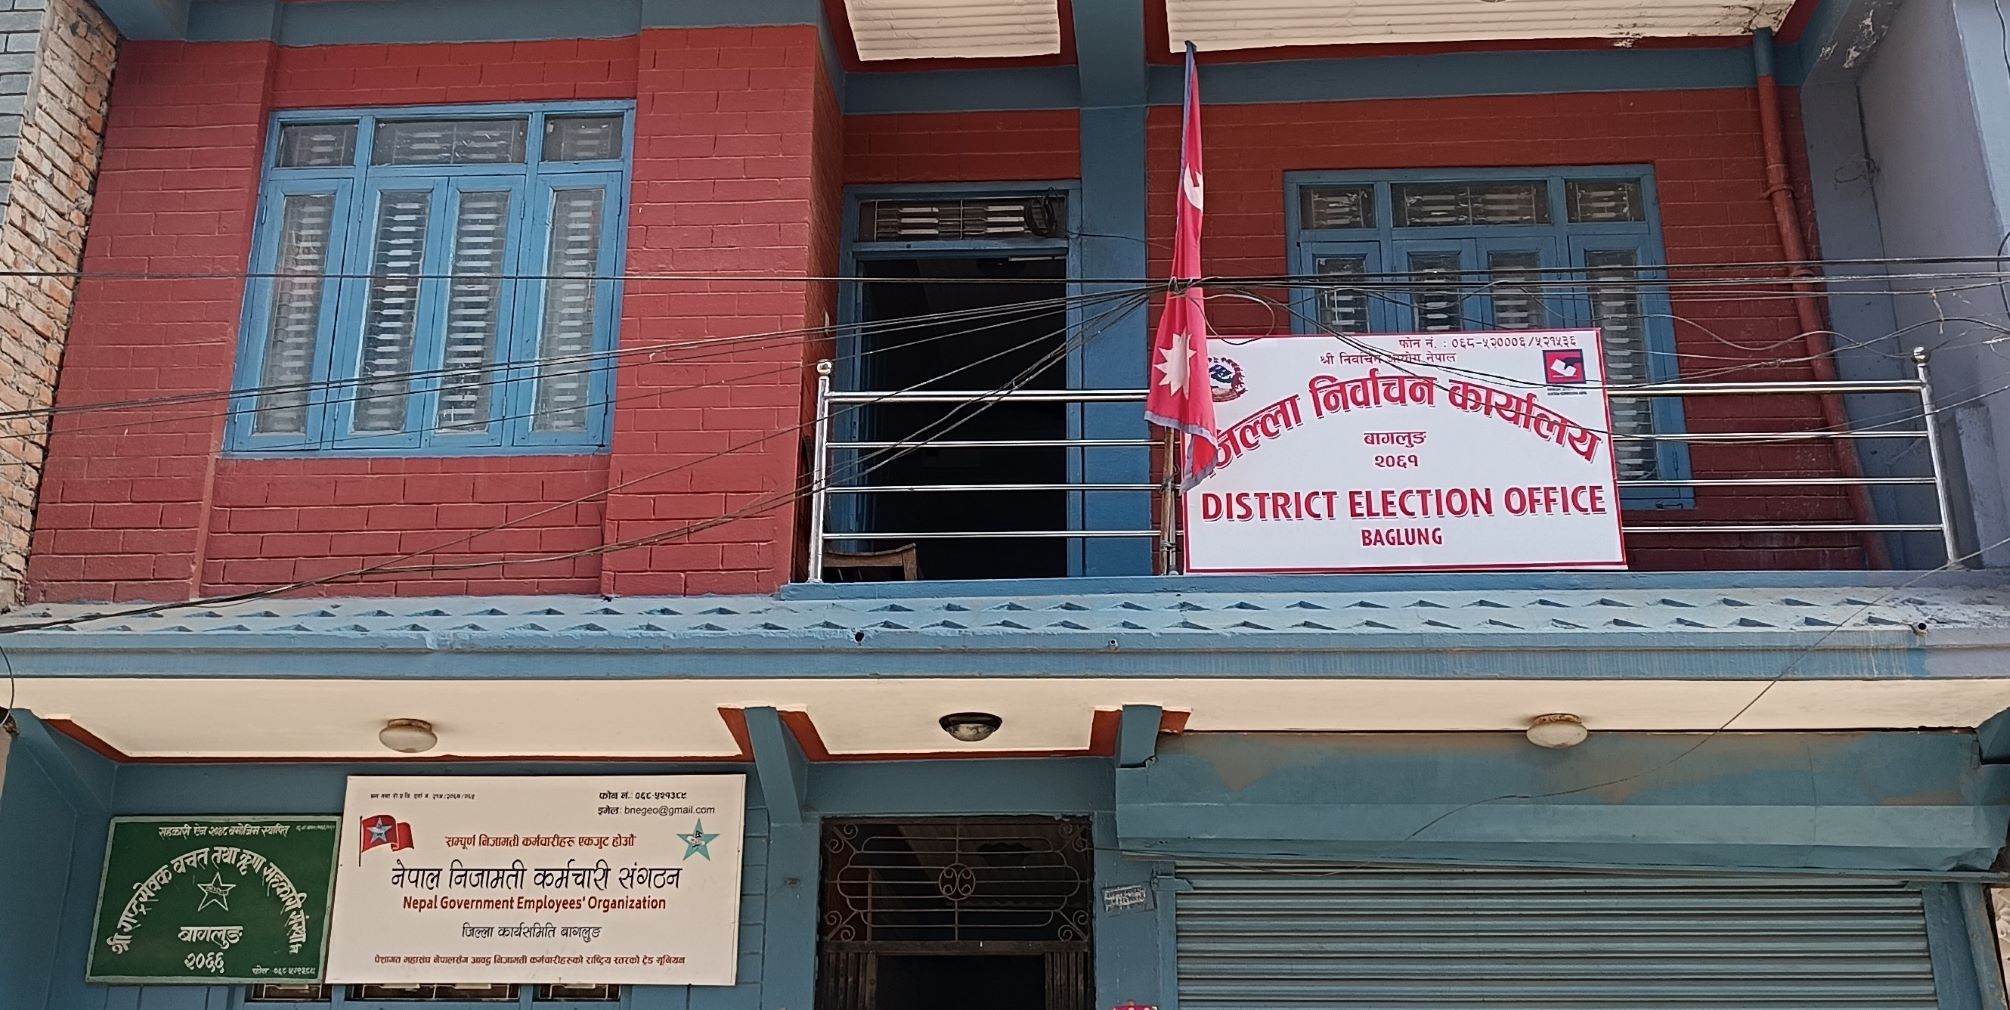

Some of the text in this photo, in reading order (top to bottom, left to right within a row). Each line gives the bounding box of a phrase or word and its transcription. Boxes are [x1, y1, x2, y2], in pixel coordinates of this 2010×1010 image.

[1398, 336, 1421, 349] फोन
[1320, 353, 1334, 365] श्री
[1426, 351, 1457, 364] नेपाल
[1309, 367, 1438, 419] निर्वाचन
[1449, 379, 1603, 464] कार्यालय
[1364, 431, 1426, 448] बागलुङ
[1375, 454, 1418, 469] २०६१
[1202, 485, 1607, 522] DISTRICT ELECTION OFFICE
[1362, 527, 1442, 546] BAGLUNG
[599, 790, 618, 800] फोन
[624, 805, 715, 816] bnegeo@gmail.com
[445, 834, 476, 850] सम्पूर्ण
[479, 834, 519, 847] निजामती
[578, 836, 609, 849] एकजुट
[391, 858, 683, 890] नेपाल निजामती कर्मचारी संगठन
[106, 933, 132, 954] श्री
[211, 846, 241, 869] तथा
[403, 895, 666, 913] Nepal Government Employees' Organization
[178, 926, 243, 950] बागलुङ
[462, 922, 602, 943] जिल्ला कार्यसमिति बागलुङ
[184, 951, 225, 974] २०६६
